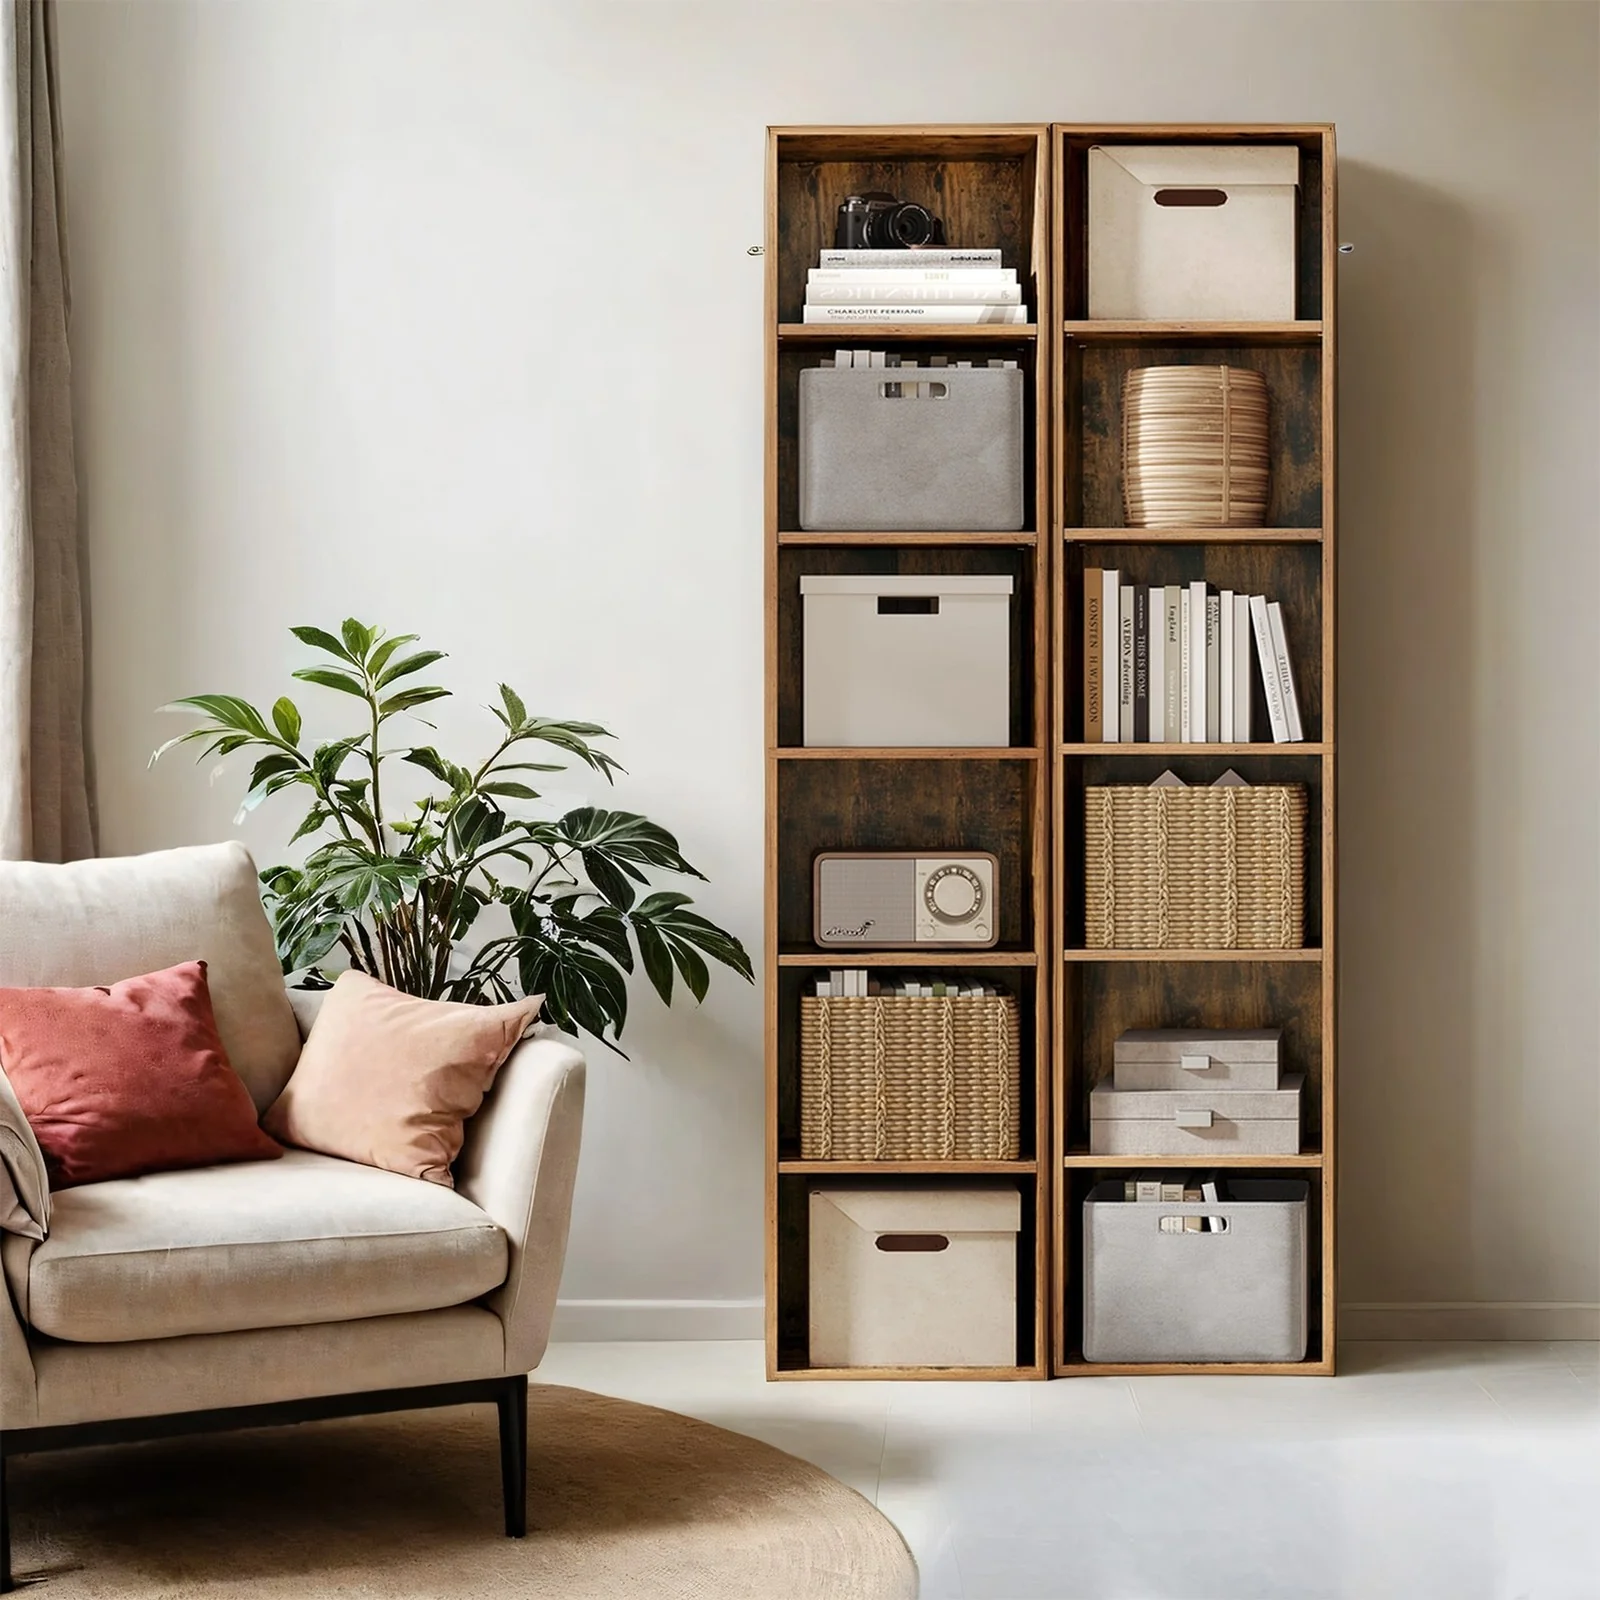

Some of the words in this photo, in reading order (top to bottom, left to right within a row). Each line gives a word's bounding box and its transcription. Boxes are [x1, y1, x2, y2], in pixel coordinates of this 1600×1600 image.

[1089, 598, 1098, 648] KONSTEN
[1122, 616, 1132, 656] AVEDON
[1167, 604, 1177, 643] England
[1137, 634, 1146, 658] THIS
[1137, 659, 1146, 668] IS
[1122, 658, 1132, 705] advertising
[1137, 669, 1146, 699] HOME
